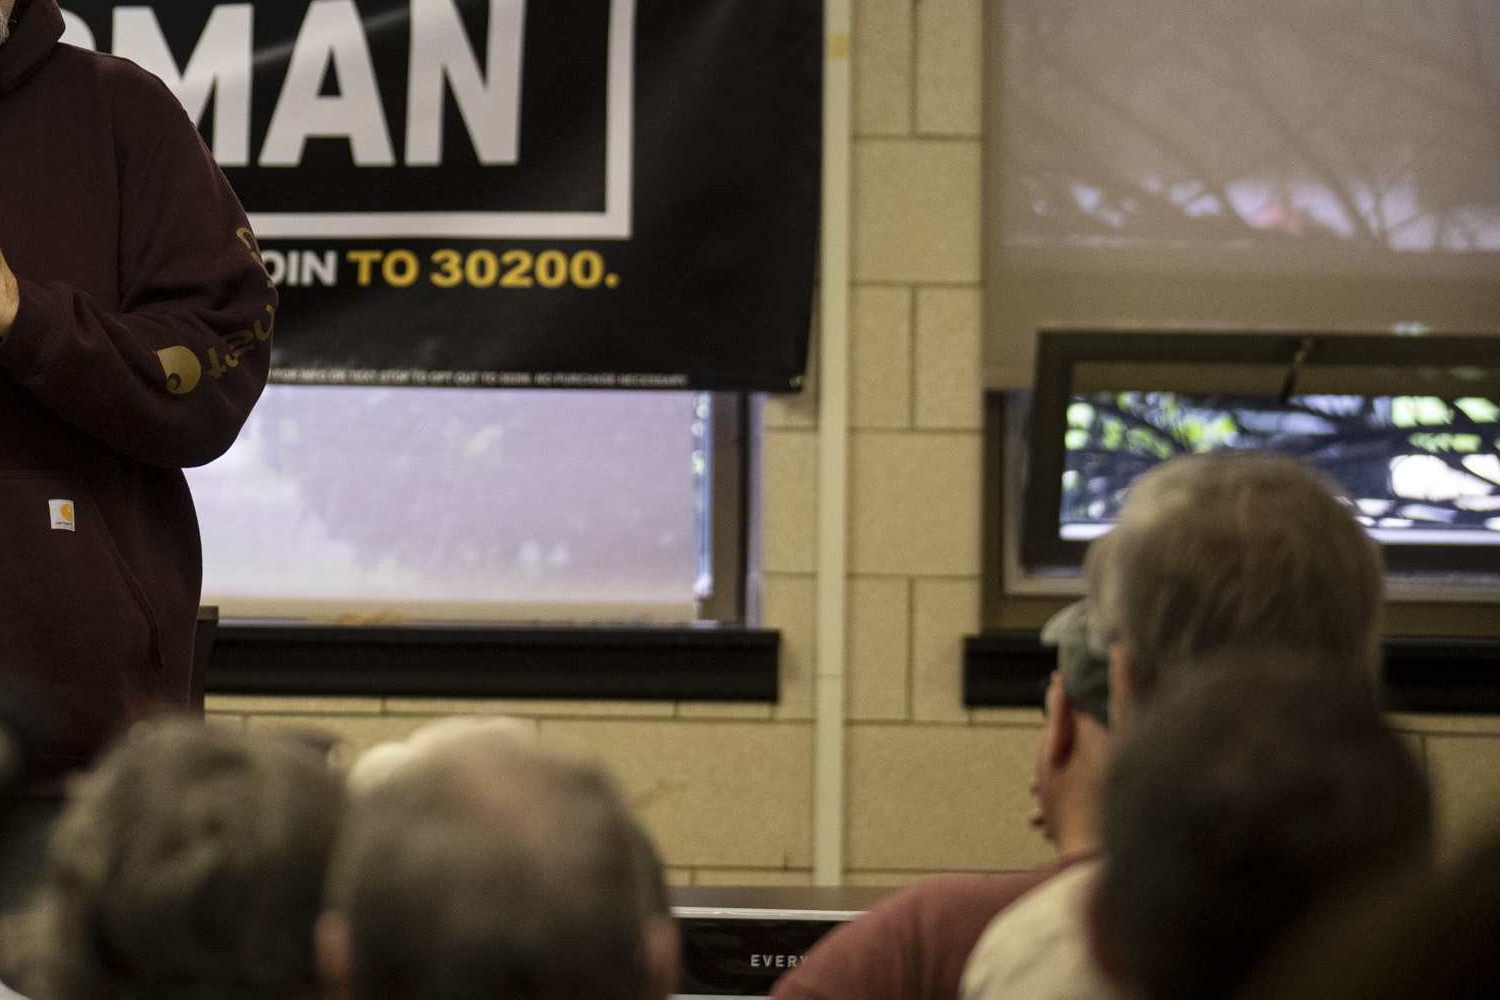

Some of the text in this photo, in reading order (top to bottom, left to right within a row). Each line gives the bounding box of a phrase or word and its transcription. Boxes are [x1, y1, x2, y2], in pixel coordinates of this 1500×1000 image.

[261, 250, 338, 287] OIN
[347, 250, 420, 287] TO
[429, 249, 620, 288] 30200.
